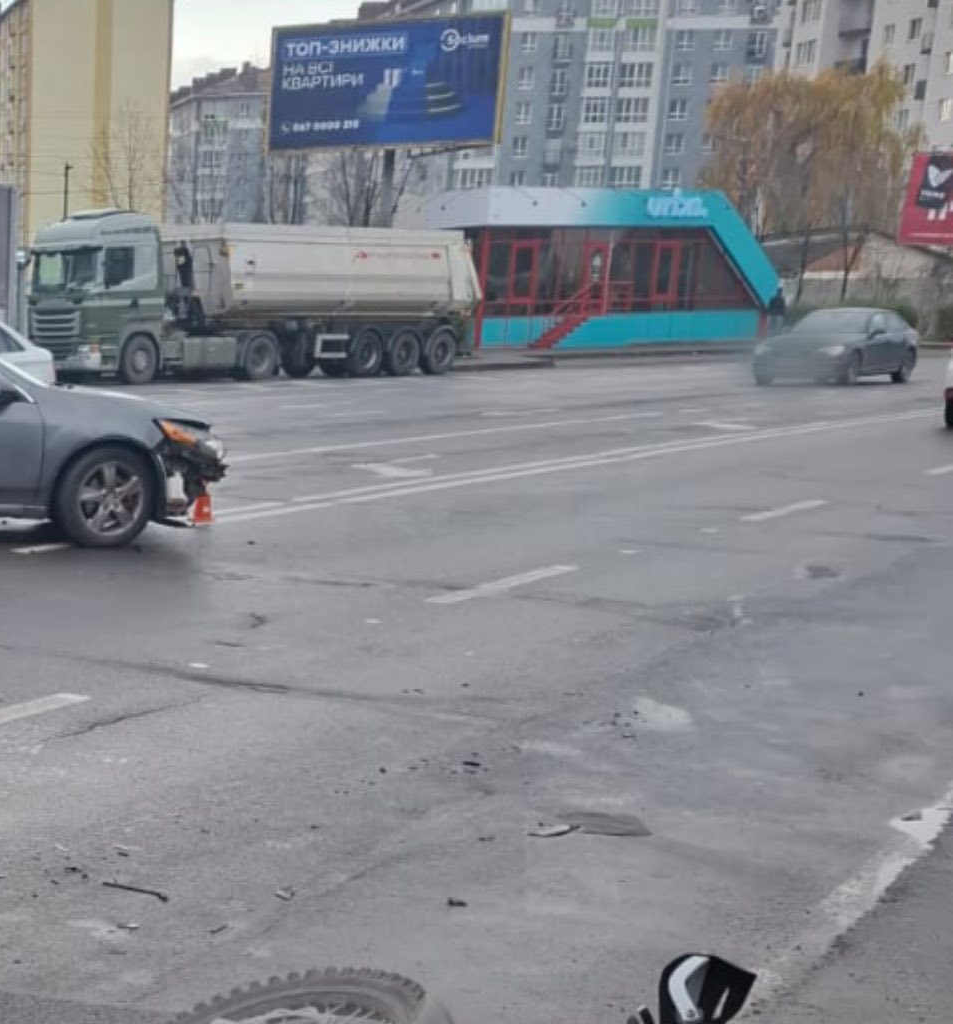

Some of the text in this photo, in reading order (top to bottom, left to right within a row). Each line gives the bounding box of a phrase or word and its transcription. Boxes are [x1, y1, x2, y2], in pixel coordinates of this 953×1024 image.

[286, 36, 405, 57] ТОП-ЗНИЖКИ
[282, 61, 334, 76] НА ВСІ
[282, 72, 364, 90] КВАРТИРИ
